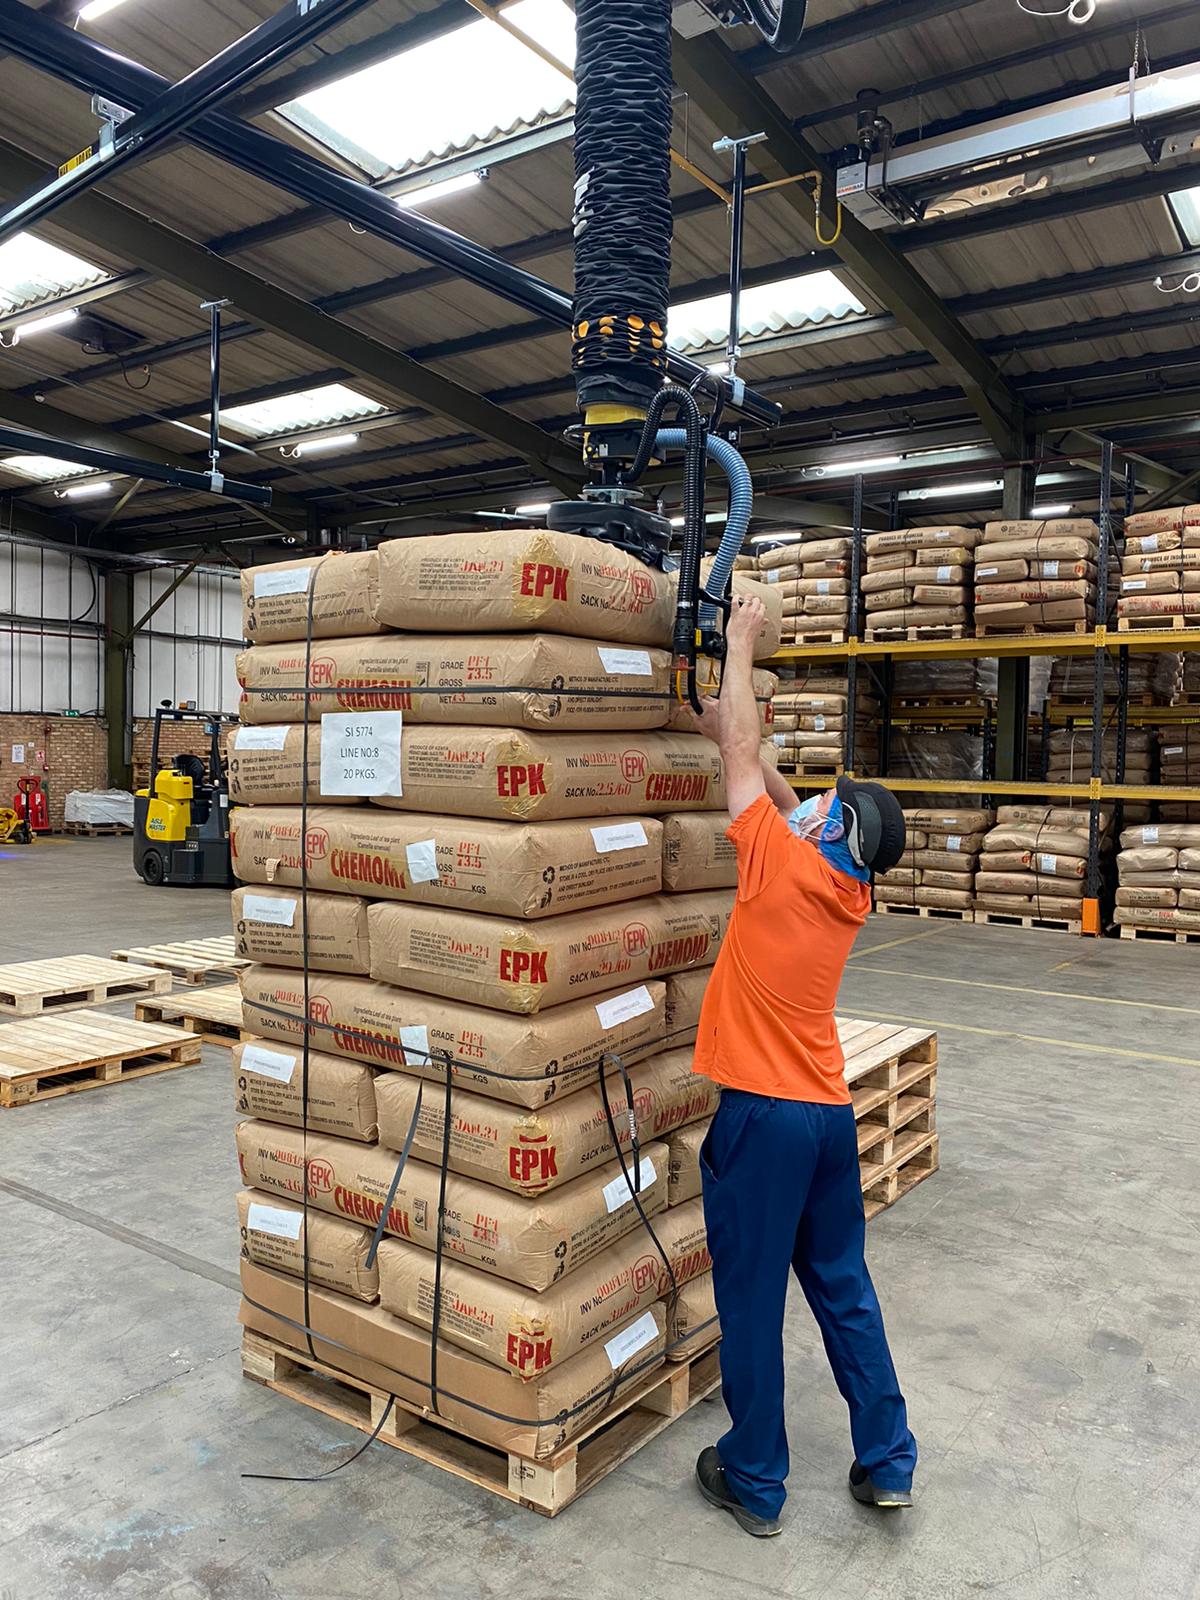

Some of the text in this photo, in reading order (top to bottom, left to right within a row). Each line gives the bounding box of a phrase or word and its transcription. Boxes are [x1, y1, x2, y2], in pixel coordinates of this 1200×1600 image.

[520, 562, 570, 601] EPK
[580, 593, 600, 608] SACK
[259, 667, 270, 676] INV
[440, 661, 464, 670] GRADE
[311, 664, 333, 684] EPK
[438, 678, 463, 687] GROSS
[260, 692, 277, 702] SACK
[481, 696, 497, 706] KGS
[355, 726, 374, 737] 5774
[340, 748, 359, 758] LINE
[566, 757, 579, 768] INV
[624, 756, 645, 777] EPK
[343, 768, 378, 779] 20 PKGS.
[496, 763, 547, 797] EPK
[564, 786, 586, 799] SACK
[645, 772, 710, 801] CHEMOMI
[306, 834, 327, 854] EPK
[435, 845, 454, 856] RADE
[471, 884, 487, 895] KGS
[626, 929, 648, 952] EPK
[568, 943, 581, 955] INV
[648, 933, 710, 972] CHEMOMI
[500, 949, 548, 983] EPK
[568, 972, 589, 985] SACK
[258, 992, 270, 1002] INV
[309, 1002, 329, 1026] EPK
[260, 1018, 276, 1029] SACK
[430, 1028, 455, 1042] GRADE
[472, 1073, 489, 1085] KGS
[257, 1148, 269, 1159] INV
[580, 1148, 599, 1164] SACK
[509, 1146, 558, 1181] EPK
[259, 1173, 277, 1186] SACK
[310, 1163, 331, 1189] EPK
[443, 1207, 462, 1222] RADE
[480, 1255, 497, 1267] KGS
[635, 1260, 656, 1291] EPK
[580, 1301, 592, 1315] INV
[580, 1326, 599, 1344] SACK
[506, 1332, 553, 1370] EPK
